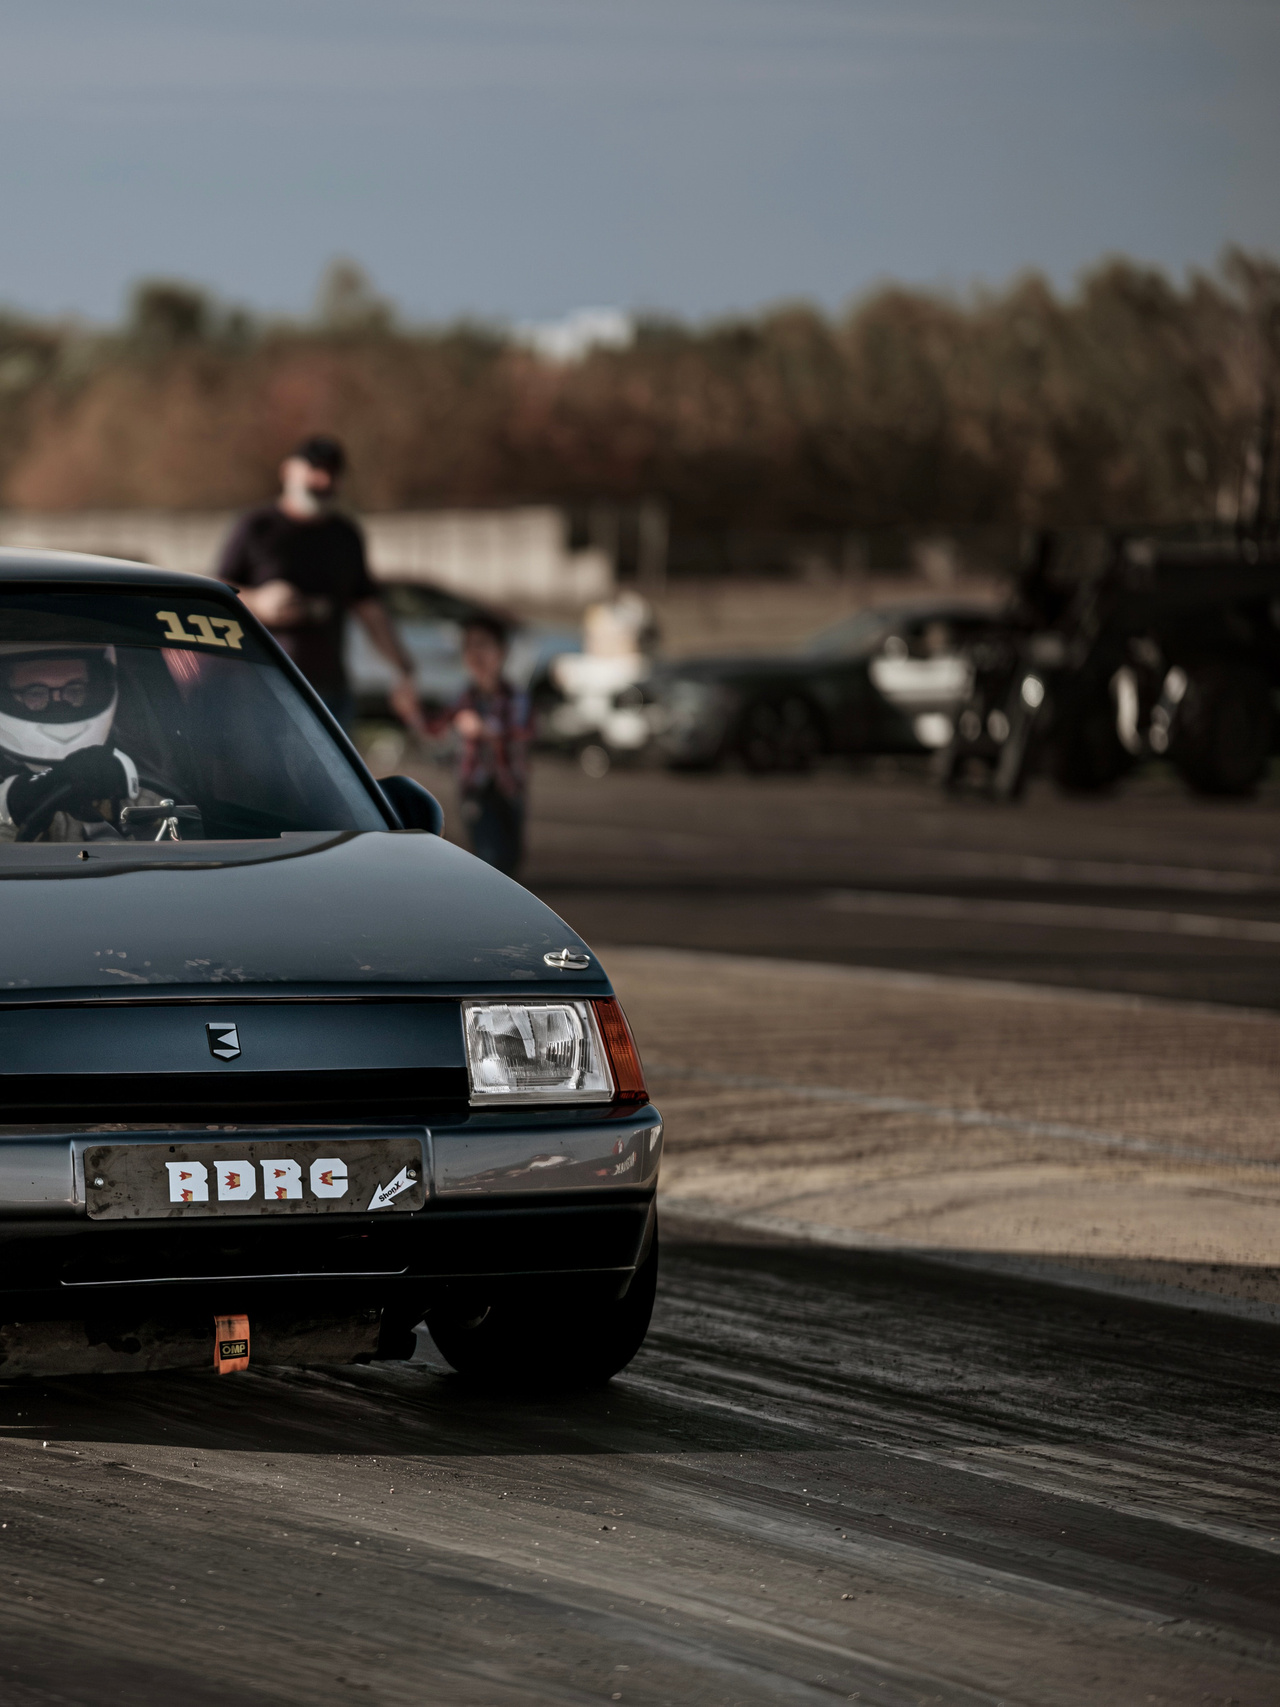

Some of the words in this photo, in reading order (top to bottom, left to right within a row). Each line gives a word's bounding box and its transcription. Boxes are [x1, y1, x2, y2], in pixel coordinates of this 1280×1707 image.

[156, 611, 244, 649] 117
[165, 1158, 348, 1202] RDRC
[379, 1181, 401, 1202] ShonX
[222, 1344, 246, 1355] OMP
